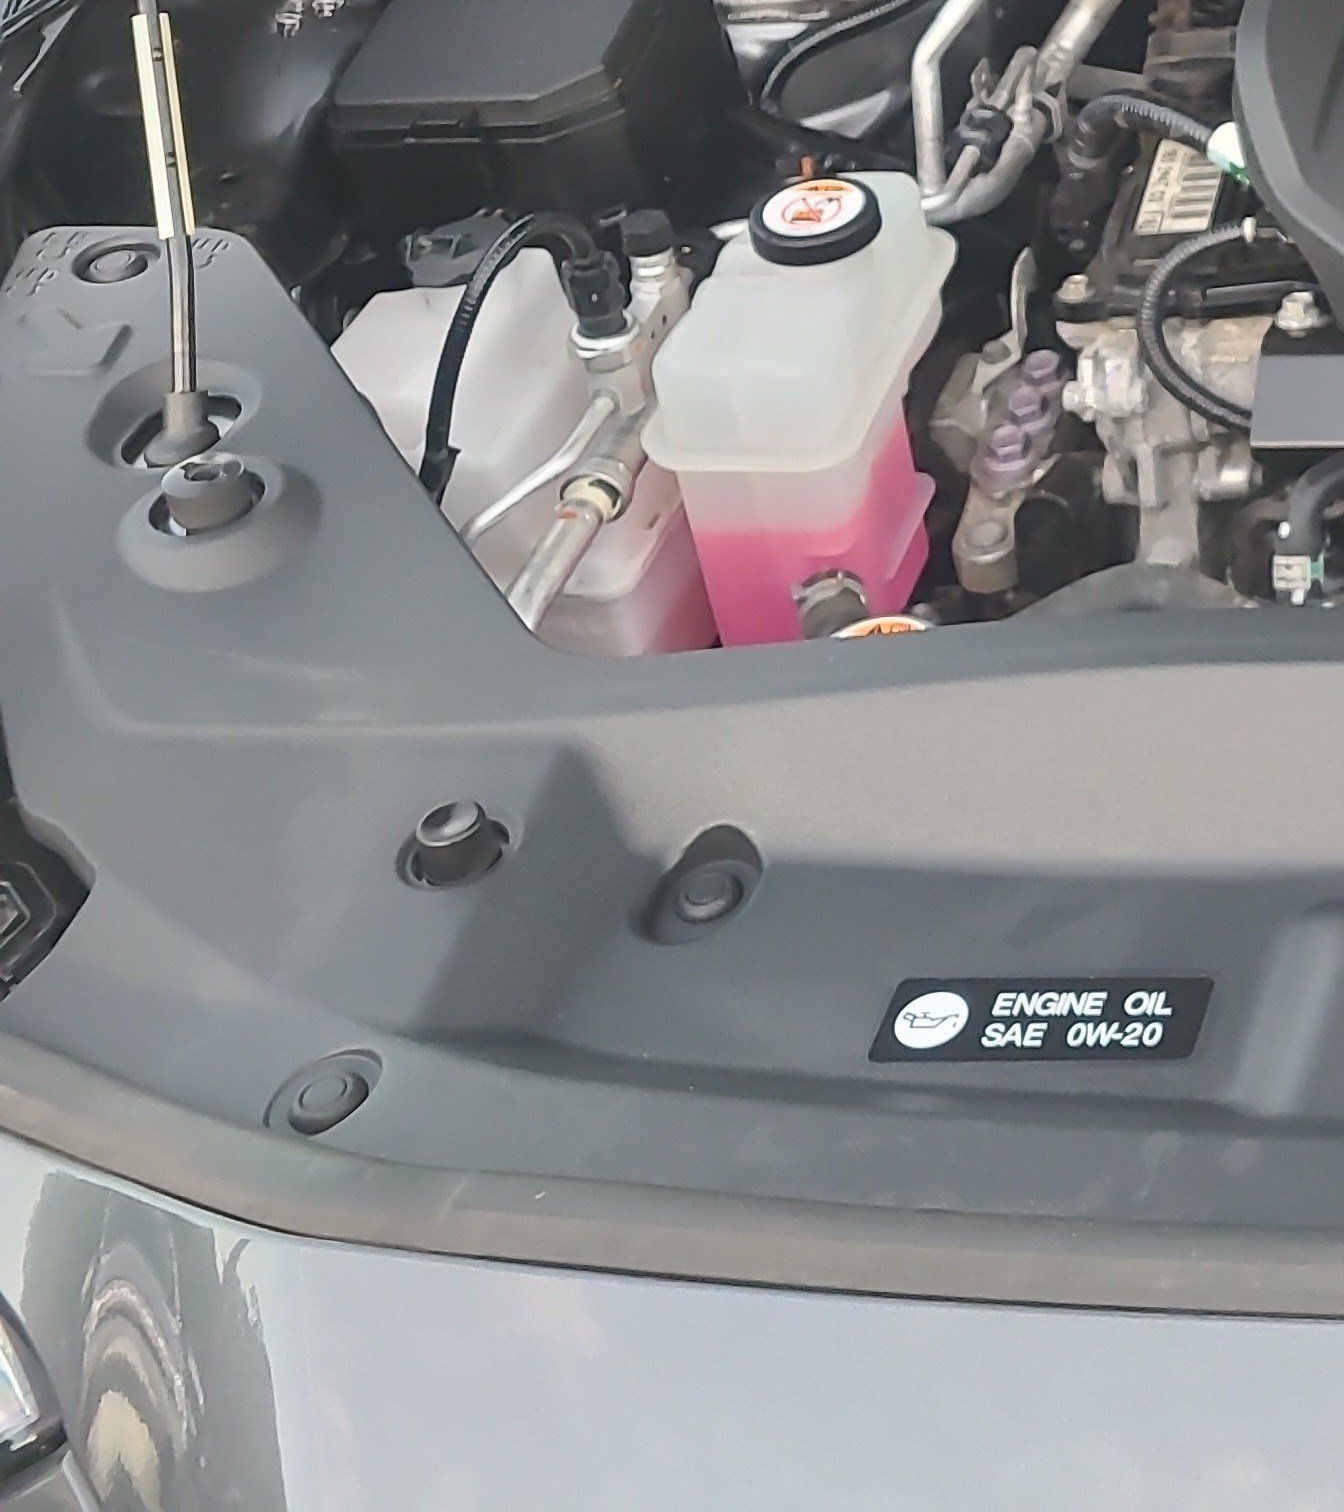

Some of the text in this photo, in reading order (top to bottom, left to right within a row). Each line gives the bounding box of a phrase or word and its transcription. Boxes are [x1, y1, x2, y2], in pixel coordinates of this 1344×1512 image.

[991, 991, 1173, 1016] ENGINE OIL
[980, 1022, 1163, 1048] SAE 0W-20
